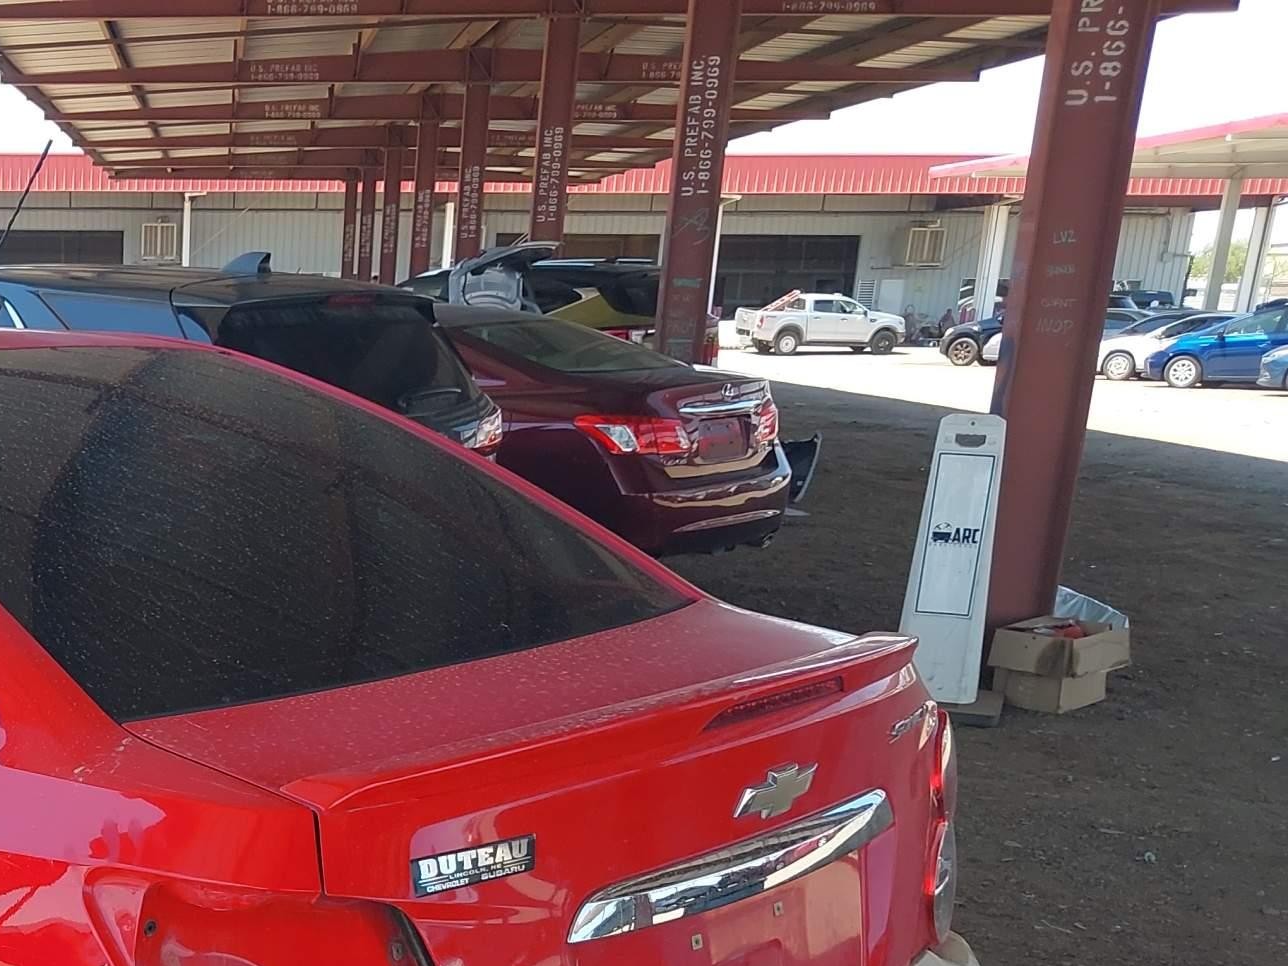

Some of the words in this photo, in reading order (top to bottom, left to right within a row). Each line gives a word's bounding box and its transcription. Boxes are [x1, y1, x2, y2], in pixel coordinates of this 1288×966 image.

[684, 95, 702, 157] PREFAB
[696, 56, 721, 194] 1-866-799-0969
[539, 152, 551, 196] PREFAB
[681, 166, 697, 196] U.S.
[951, 527, 980, 544] ARC
[418, 838, 529, 880] DUTEAU
[427, 878, 470, 893] CHEVROLET
[481, 864, 526, 880] SUBARU
